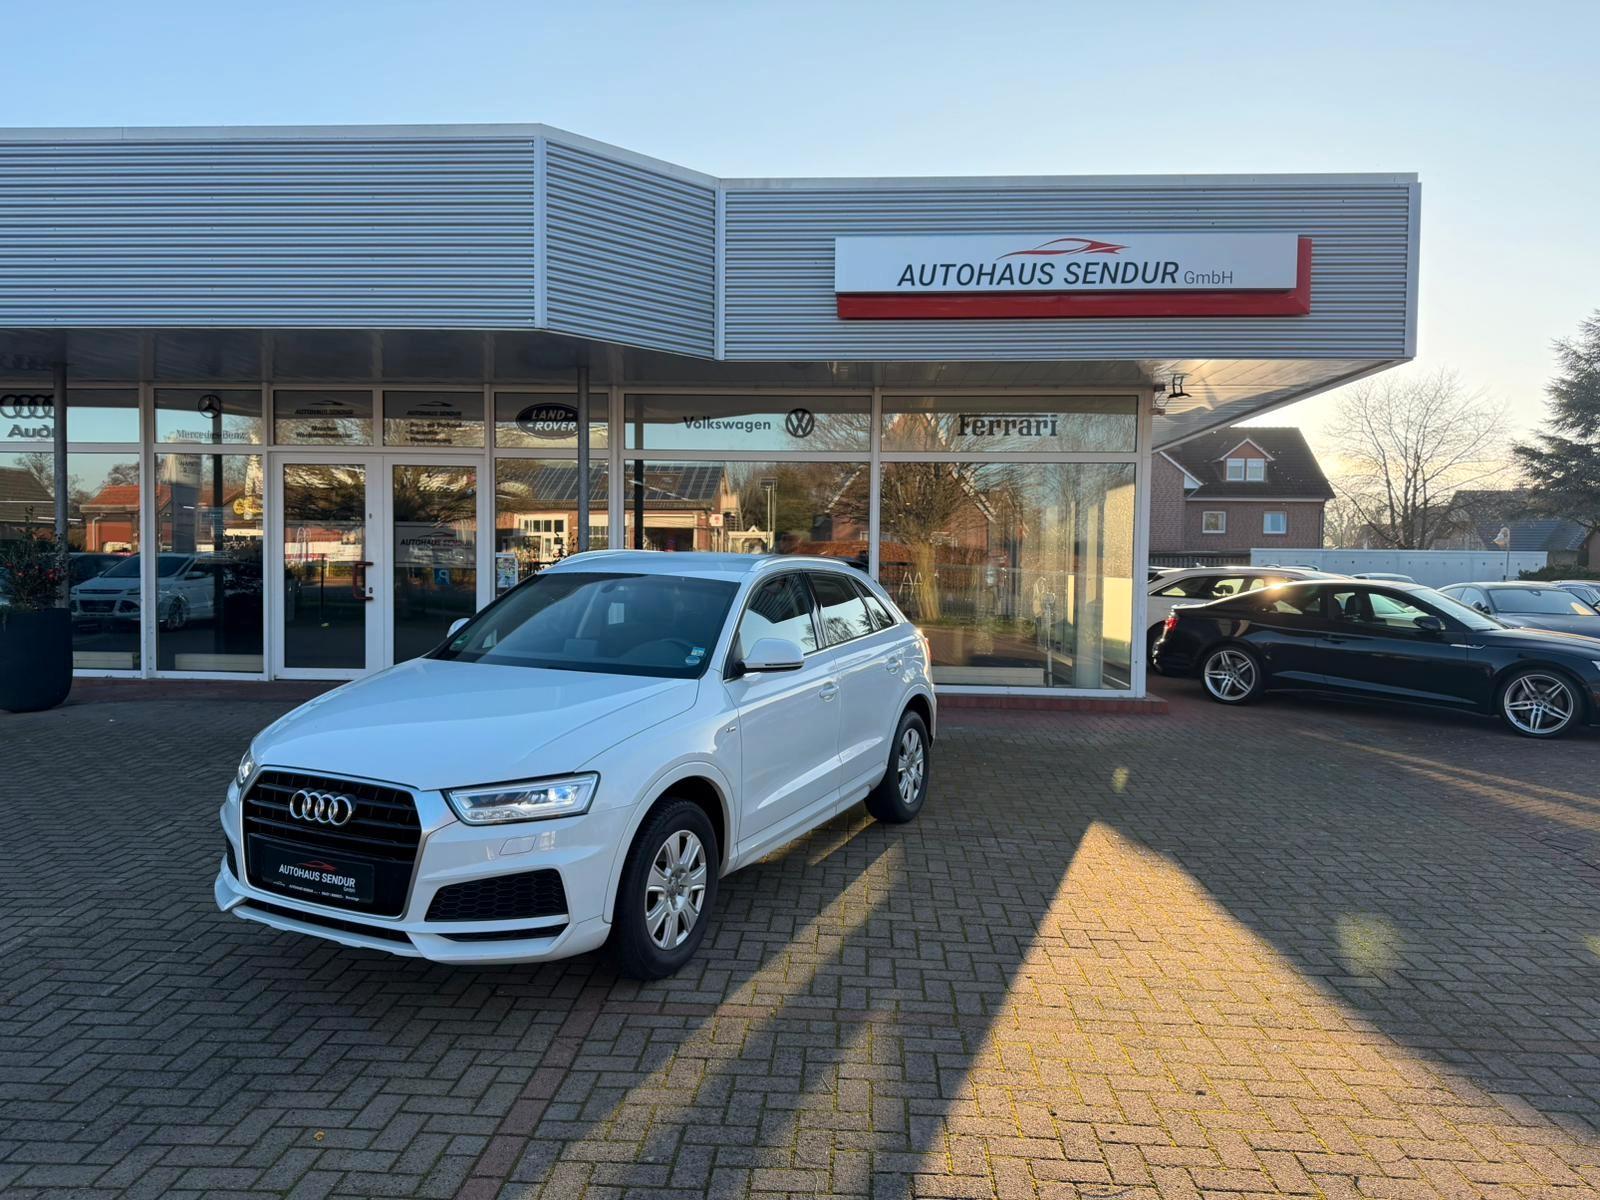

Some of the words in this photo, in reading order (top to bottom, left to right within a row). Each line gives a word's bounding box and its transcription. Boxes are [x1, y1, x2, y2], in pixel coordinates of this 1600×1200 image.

[897, 262, 1056, 287] AUTOHAUS
[1063, 261, 1180, 285] SENDUR
[1184, 270, 1234, 284] GmbH
[683, 415, 771, 433] Volkswagen
[956, 414, 1058, 437] Ferrari
[279, 864, 320, 881] AUTOHAUS
[321, 873, 356, 887] SENDUR
